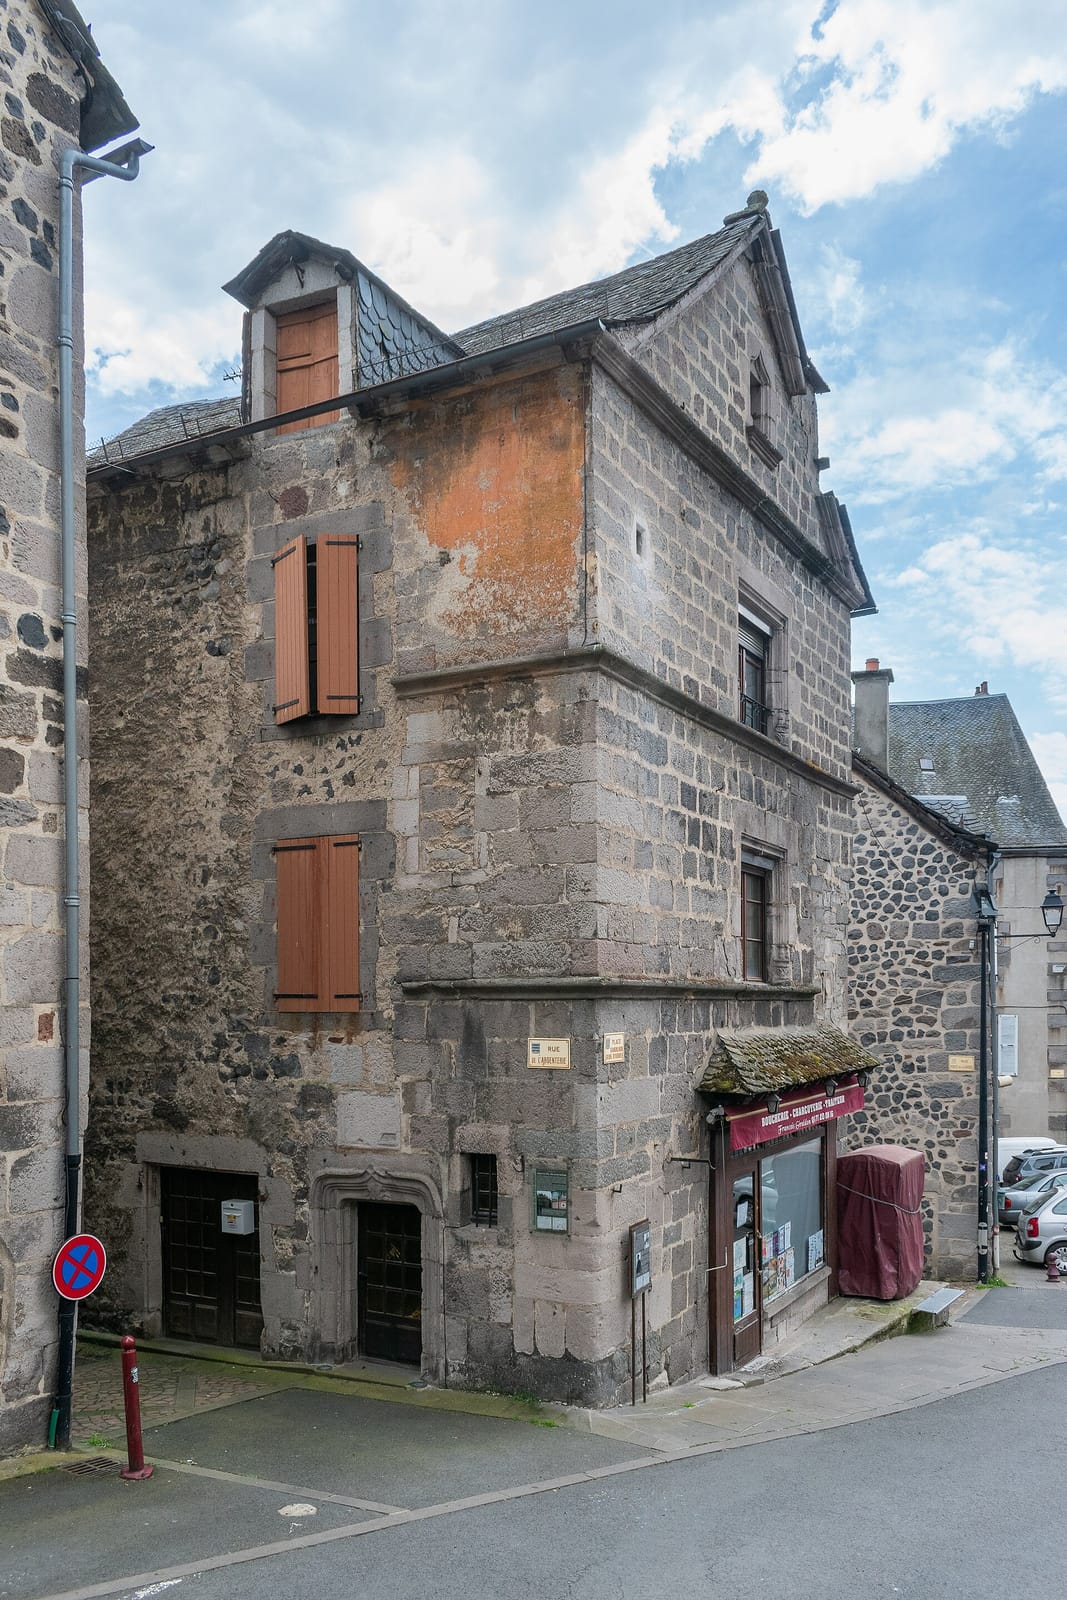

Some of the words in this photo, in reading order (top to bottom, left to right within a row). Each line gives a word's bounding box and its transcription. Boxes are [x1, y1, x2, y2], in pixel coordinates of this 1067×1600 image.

[762, 1111, 789, 1126] BOUCHERIE
[792, 1101, 822, 1117] CHARCUTERIE
[825, 1095, 845, 1107] TRAITEUR
